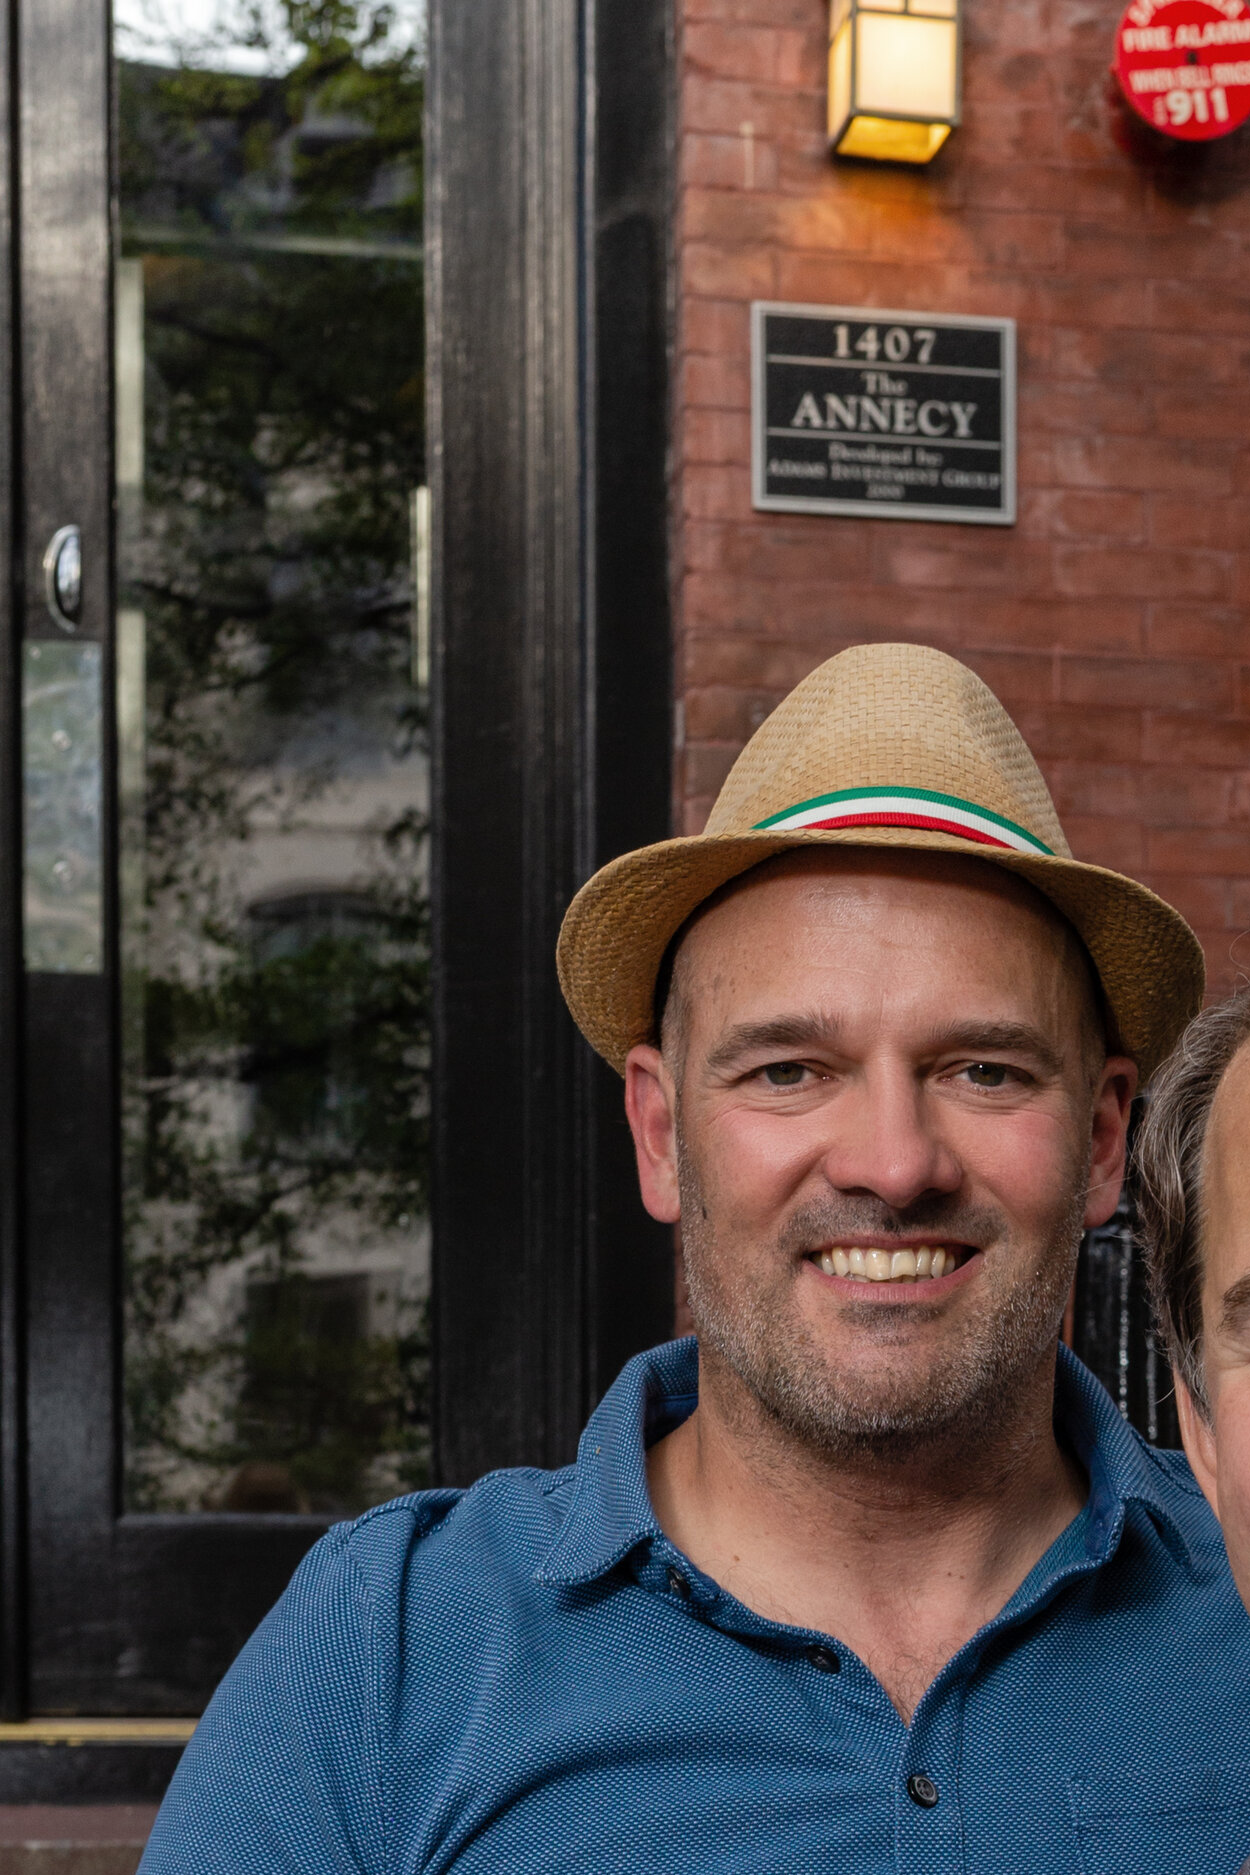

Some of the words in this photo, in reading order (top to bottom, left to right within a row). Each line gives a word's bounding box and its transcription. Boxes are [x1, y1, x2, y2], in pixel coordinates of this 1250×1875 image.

[1122, 25, 1174, 53] FIRE
[1165, 86, 1229, 126] 911
[834, 324, 936, 364] 1407
[860, 370, 909, 396] The
[793, 392, 977, 437] ANNECY
